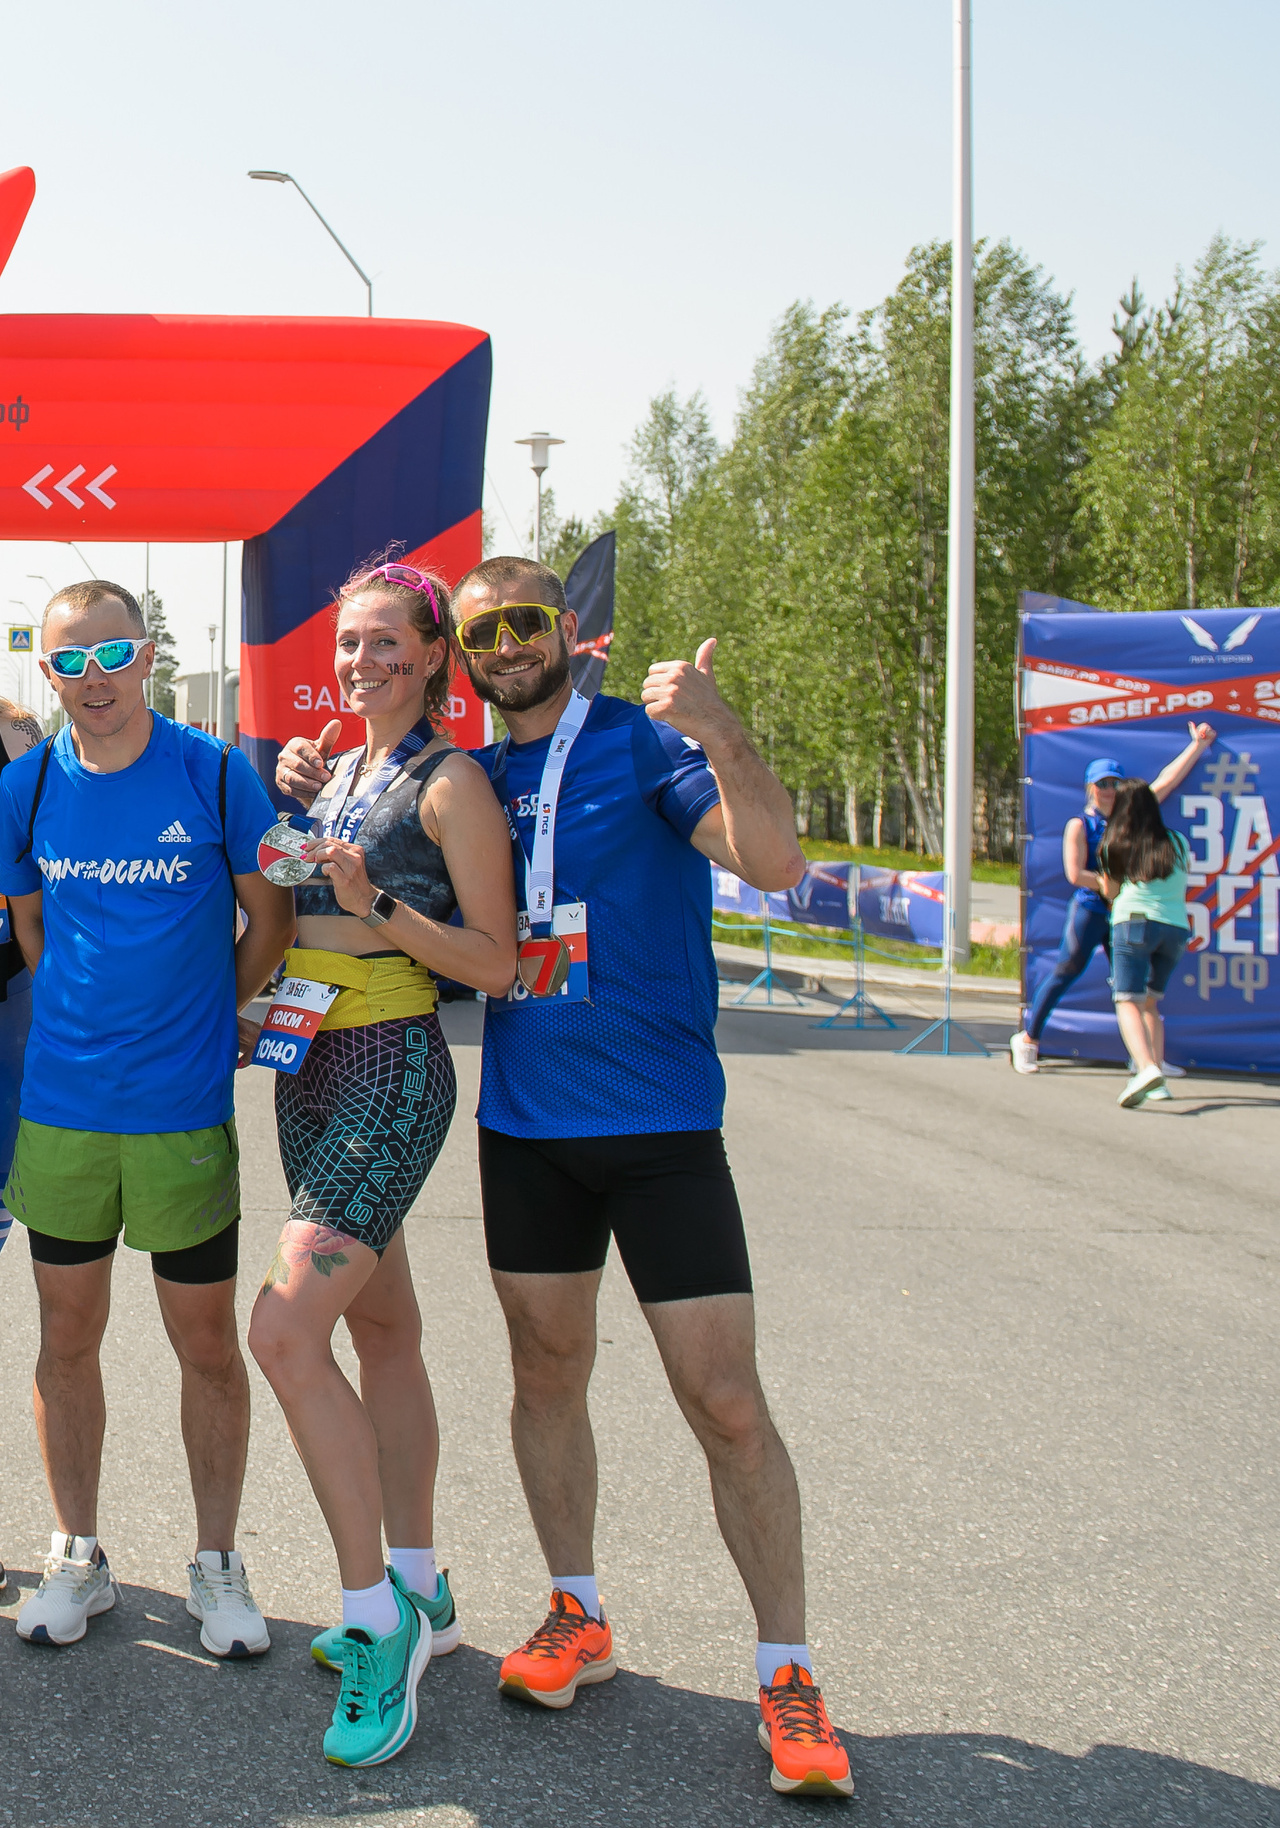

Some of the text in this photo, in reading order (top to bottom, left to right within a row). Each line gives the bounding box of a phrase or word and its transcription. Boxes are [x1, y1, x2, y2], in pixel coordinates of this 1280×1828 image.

[1068, 690, 1214, 725] ЗАБЕГ.РФ
[157, 833, 192, 843] adidas
[80, 860, 101, 870] FOR
[82, 870, 101, 880] THE
[100, 854, 192, 884] OCEANS
[256, 1038, 298, 1065] 10140
[344, 1026, 428, 1226] STAY AHEAD
